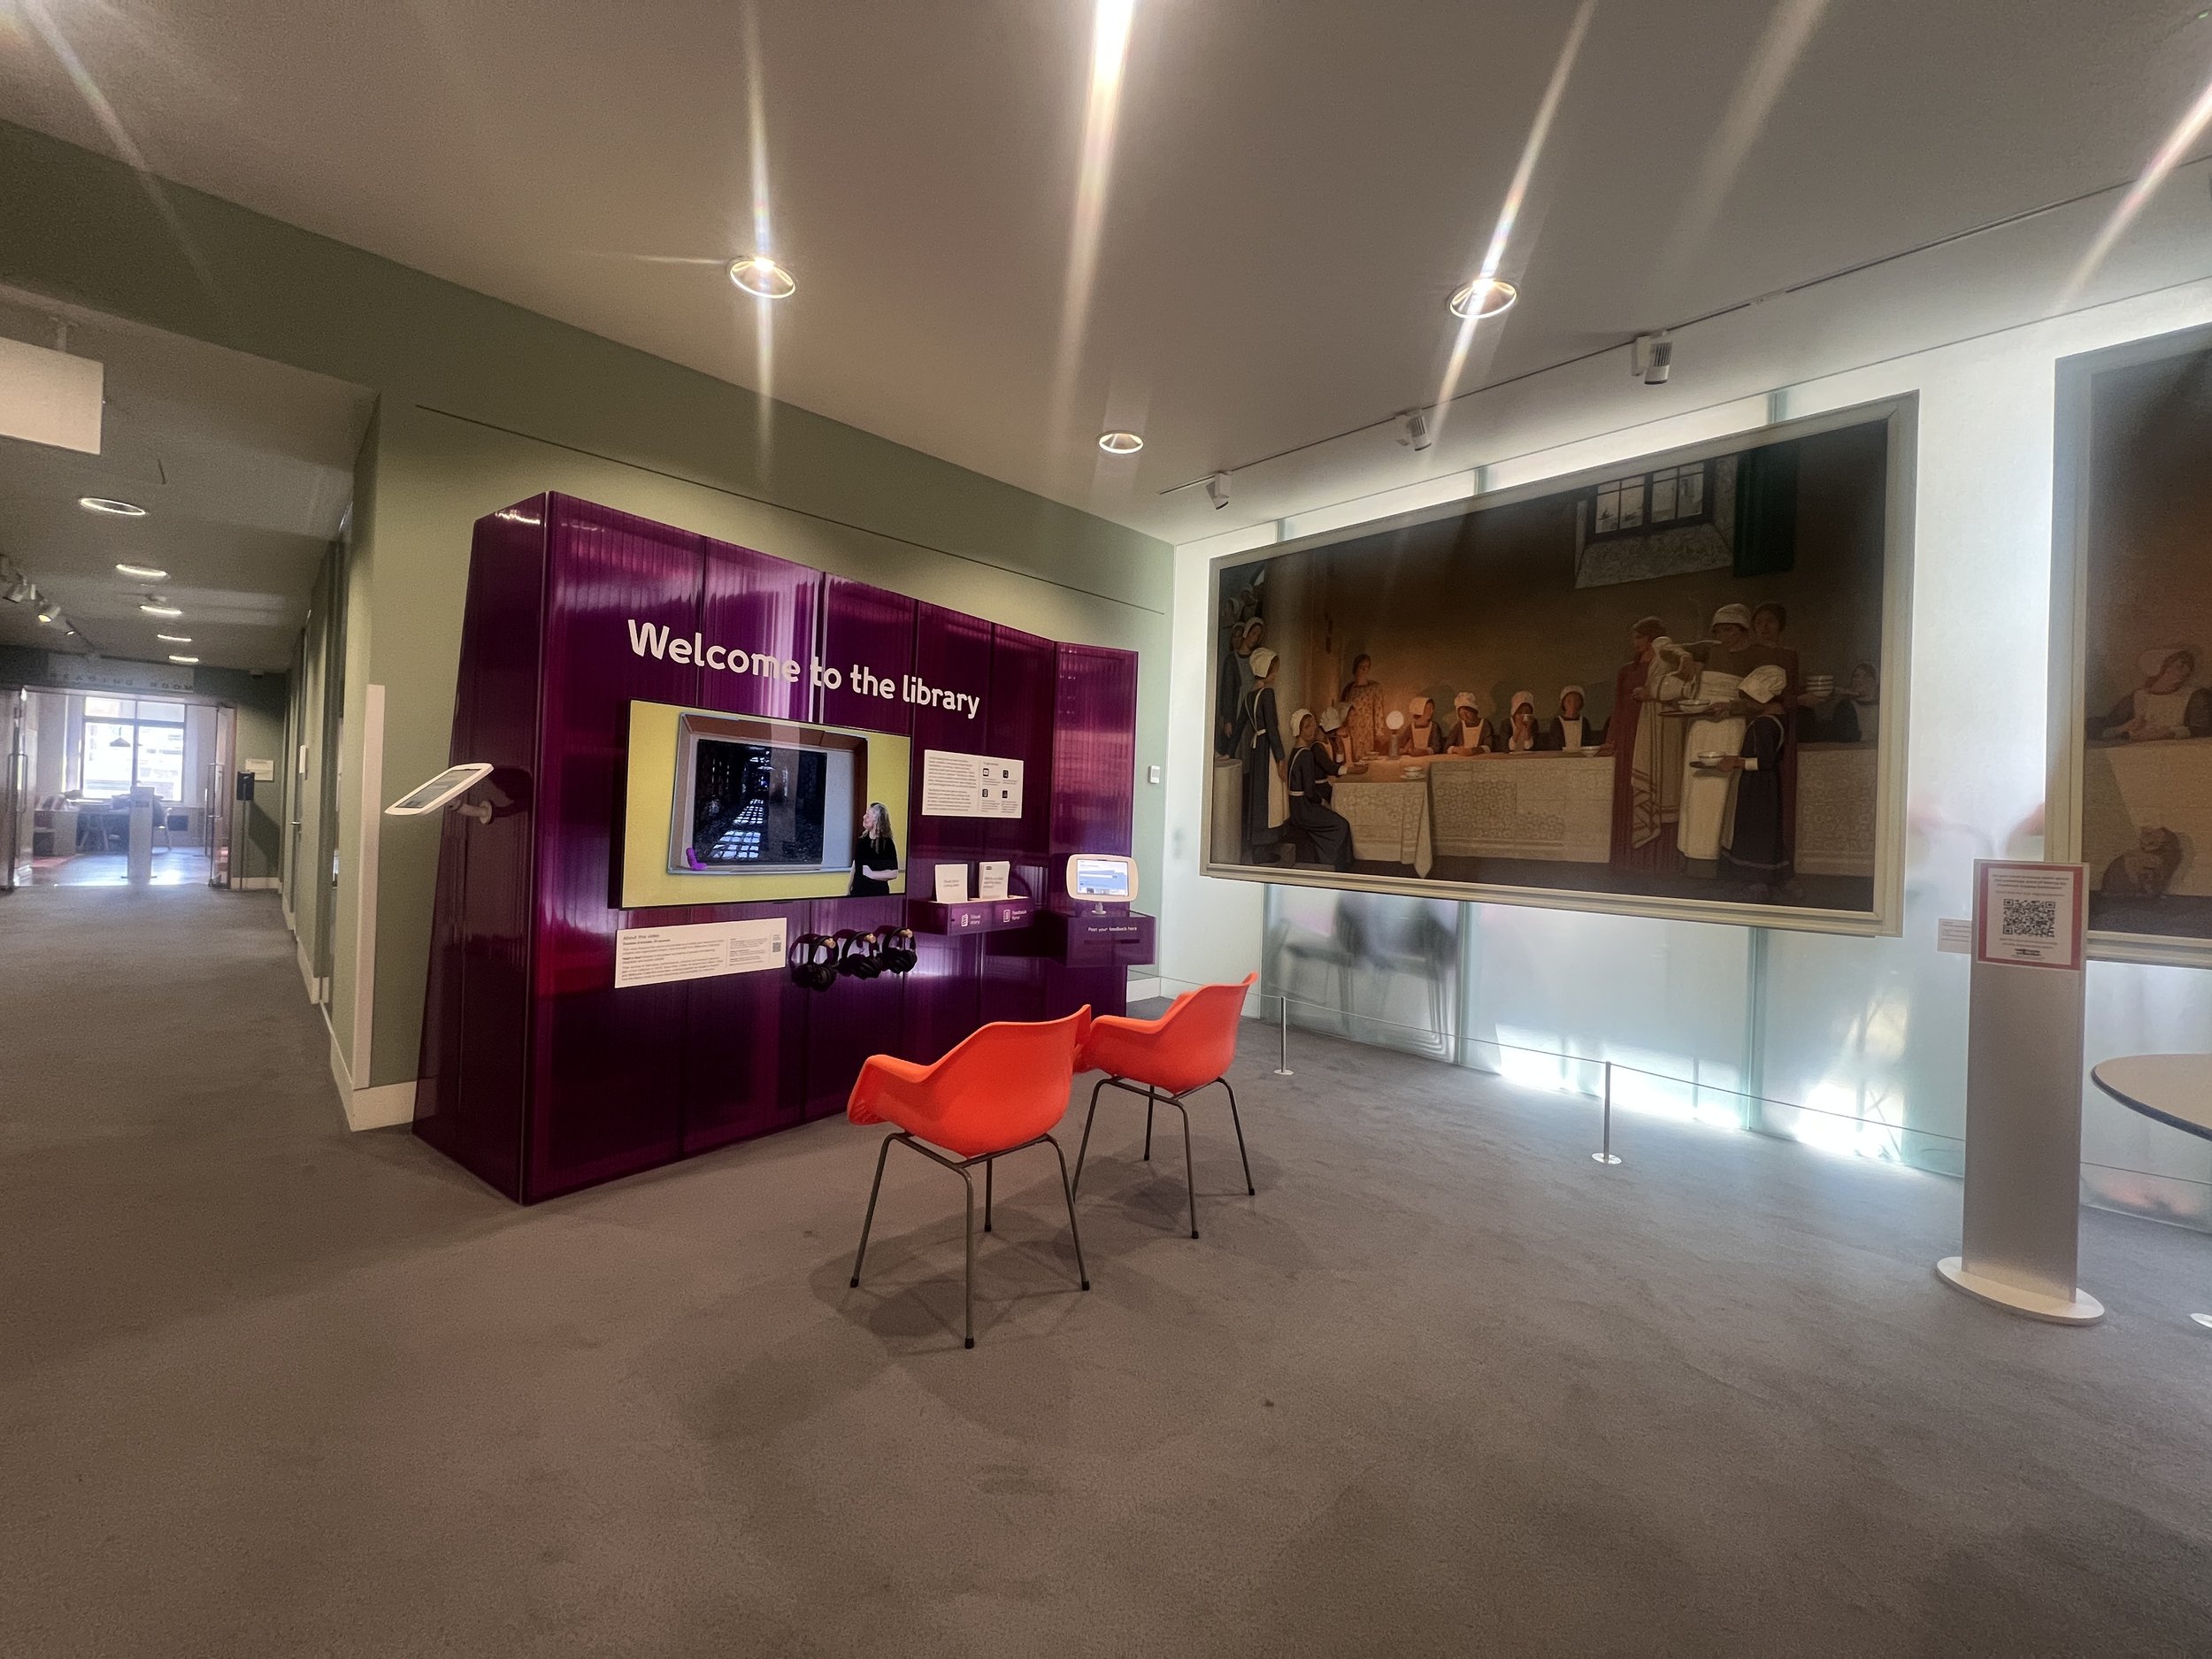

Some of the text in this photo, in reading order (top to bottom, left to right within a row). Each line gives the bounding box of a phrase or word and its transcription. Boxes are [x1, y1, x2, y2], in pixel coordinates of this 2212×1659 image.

[150, 681, 192, 691] ROOM
[627, 619, 979, 718] Welcome to the library
